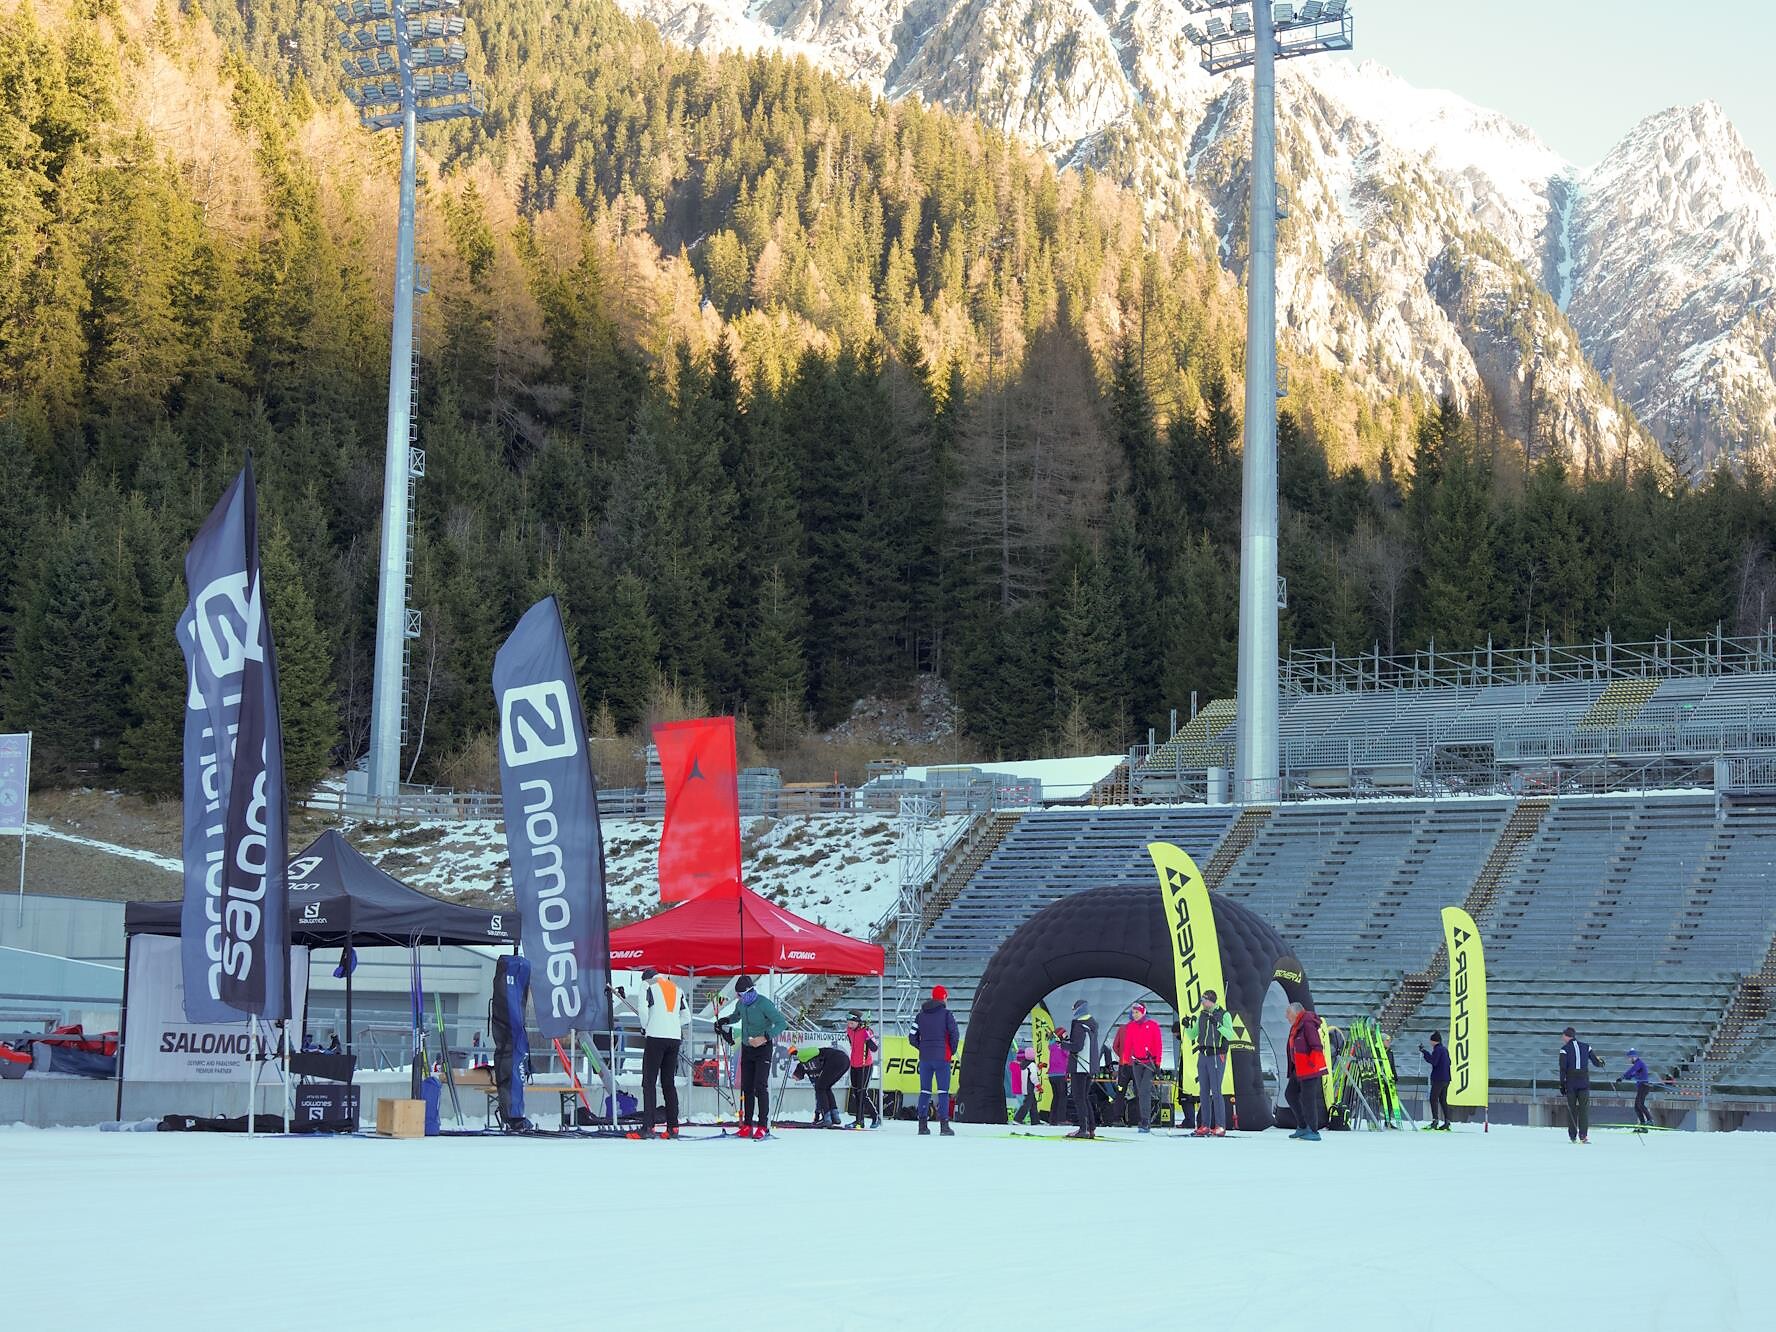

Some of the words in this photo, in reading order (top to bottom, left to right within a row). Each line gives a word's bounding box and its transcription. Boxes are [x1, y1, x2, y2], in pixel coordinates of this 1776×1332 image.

[223, 737, 267, 981] salom
[608, 950, 644, 959] OMIC
[787, 951, 816, 960] ATOMIC
